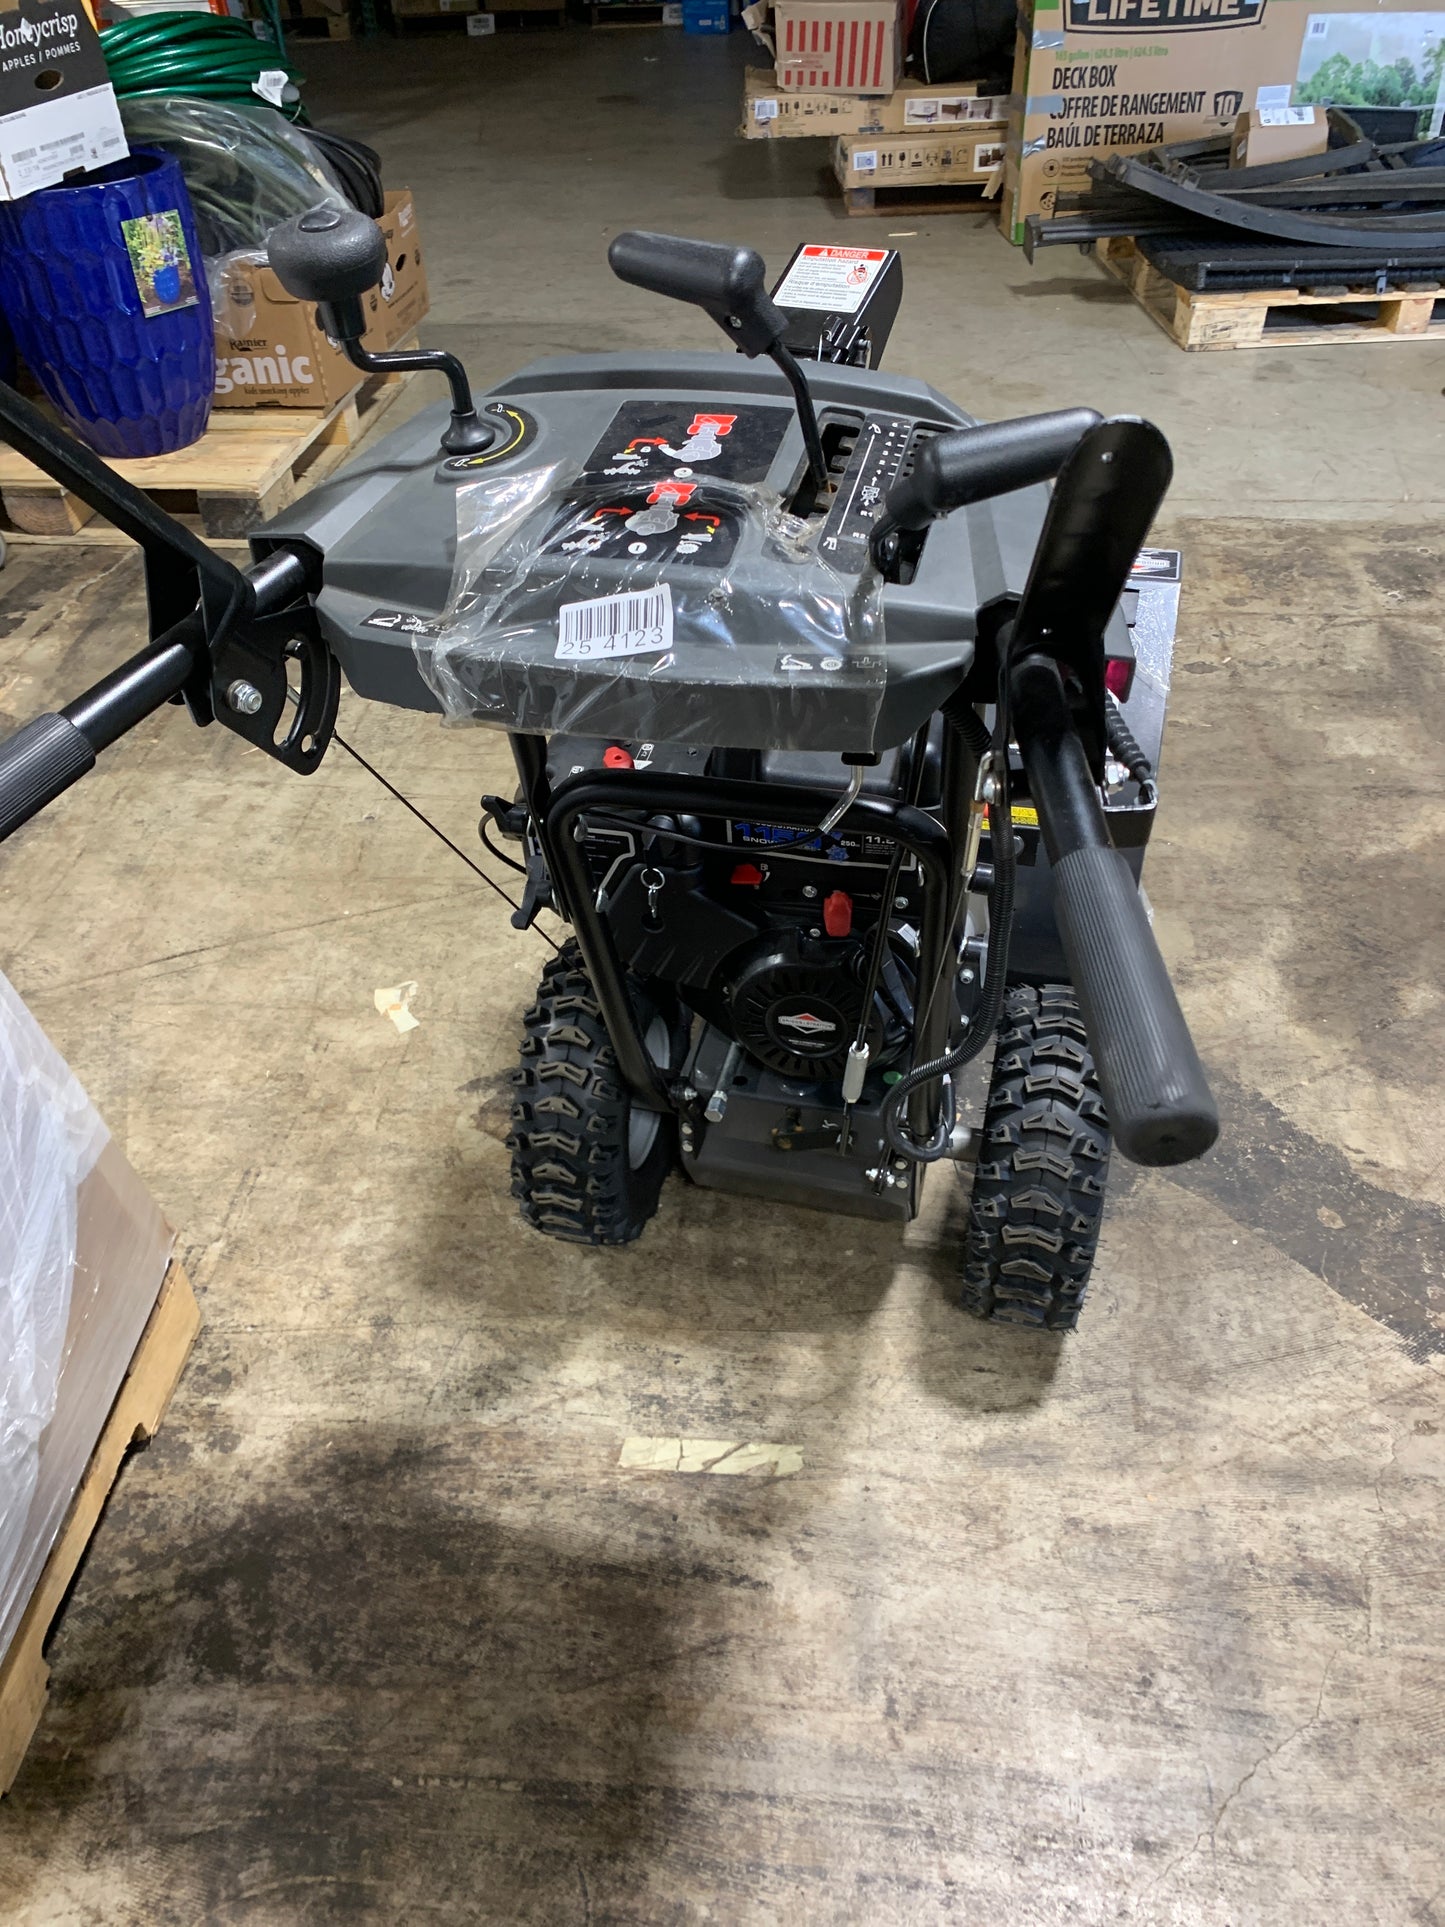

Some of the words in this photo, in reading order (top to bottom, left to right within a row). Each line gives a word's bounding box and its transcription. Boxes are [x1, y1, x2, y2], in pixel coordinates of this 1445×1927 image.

[1088, 0, 1241, 21] LIFETIME
[2, 52, 36, 73] APPLES
[45, 41, 81, 60] POMMES
[1052, 67, 1086, 90] DECK
[1090, 65, 1118, 88] BOX
[1050, 95, 1098, 119] OFFRE
[1099, 94, 1119, 117] DE
[1121, 91, 1206, 115] RANGEMENT
[1216, 94, 1236, 117] 10
[1046, 121, 1081, 149] BAÚL
[1082, 124, 1102, 147] DE
[1103, 121, 1164, 146] TERRAZA
[830, 249, 869, 259] DANGER
[214, 344, 315, 394] ganic
[561, 639, 592, 655] 25
[603, 626, 664, 651] 4123
